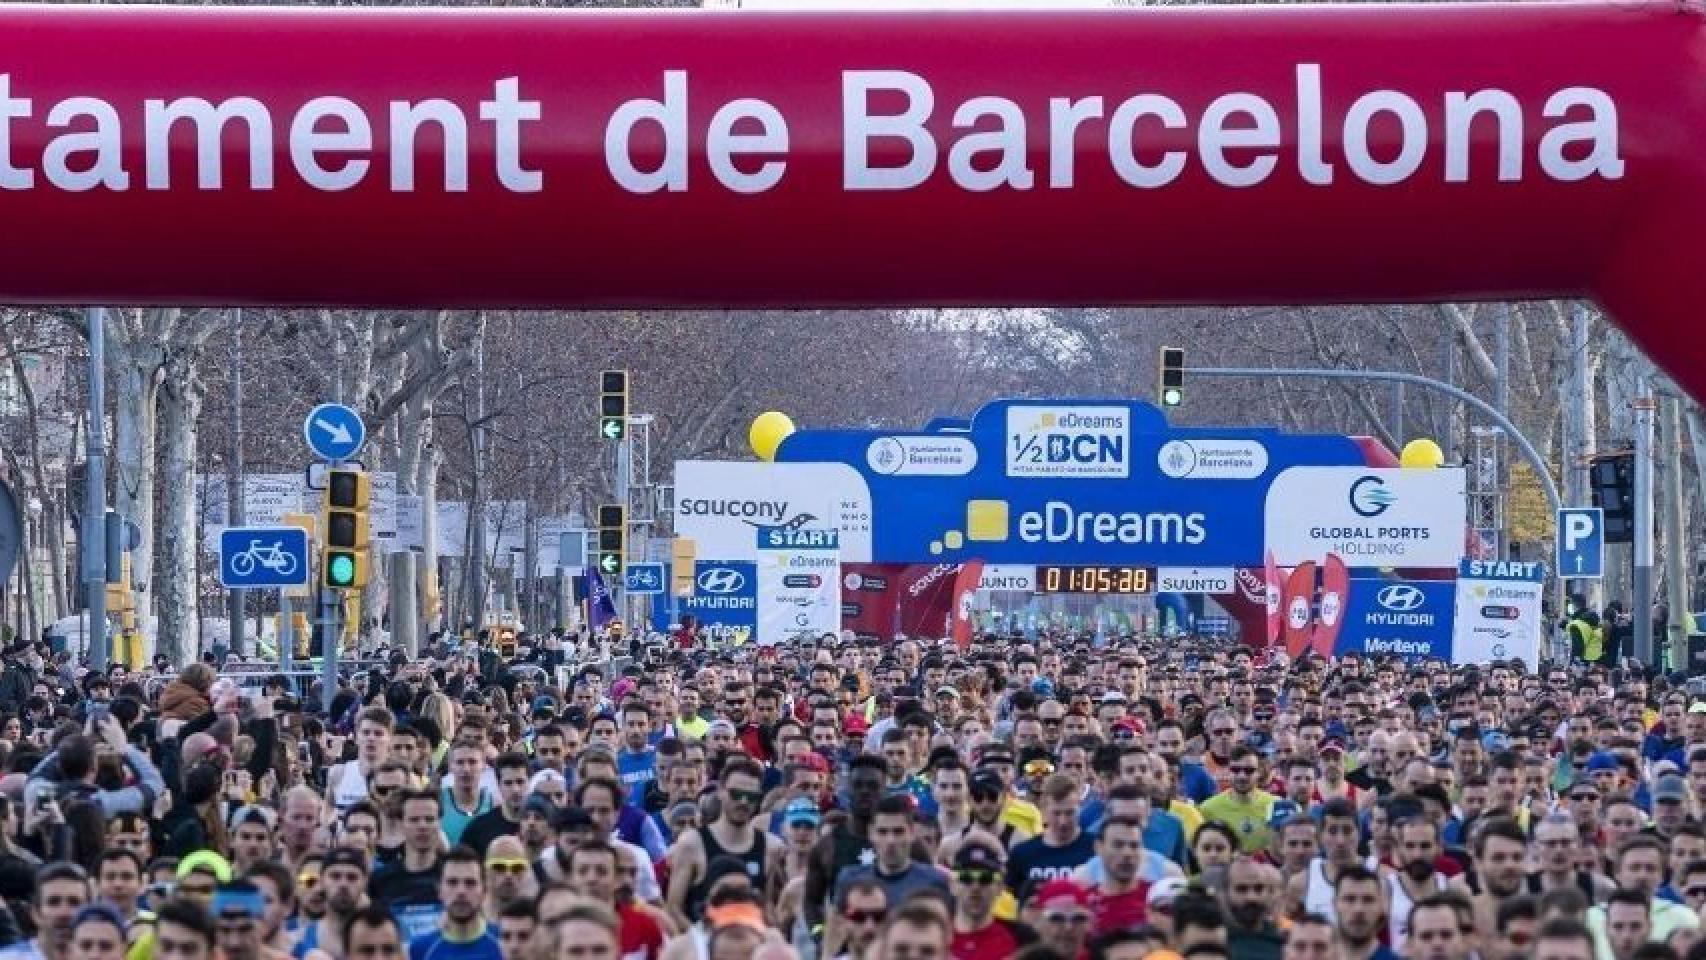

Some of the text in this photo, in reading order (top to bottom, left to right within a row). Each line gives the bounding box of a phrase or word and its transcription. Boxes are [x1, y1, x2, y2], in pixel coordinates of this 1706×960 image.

[604, 69, 789, 193] de
[842, 63, 1625, 192] Barcelona
[1058, 412, 1123, 429] eDreams
[1047, 434, 1123, 463] BCN
[909, 454, 963, 464] Barcelona
[1199, 458, 1253, 467] Barcelona
[679, 497, 789, 522] saucony
[1018, 501, 1206, 544] eDreams
[768, 530, 836, 546] START
[1309, 527, 1431, 539] GLOBAL PORTS
[1565, 513, 1594, 551] P
[1333, 542, 1405, 555] HOLDING
[1469, 560, 1537, 577] START
[1162, 577, 1227, 591] SUUNTO
[687, 596, 755, 609] HYUNDAI
[1365, 613, 1435, 626] HYUNDAI
